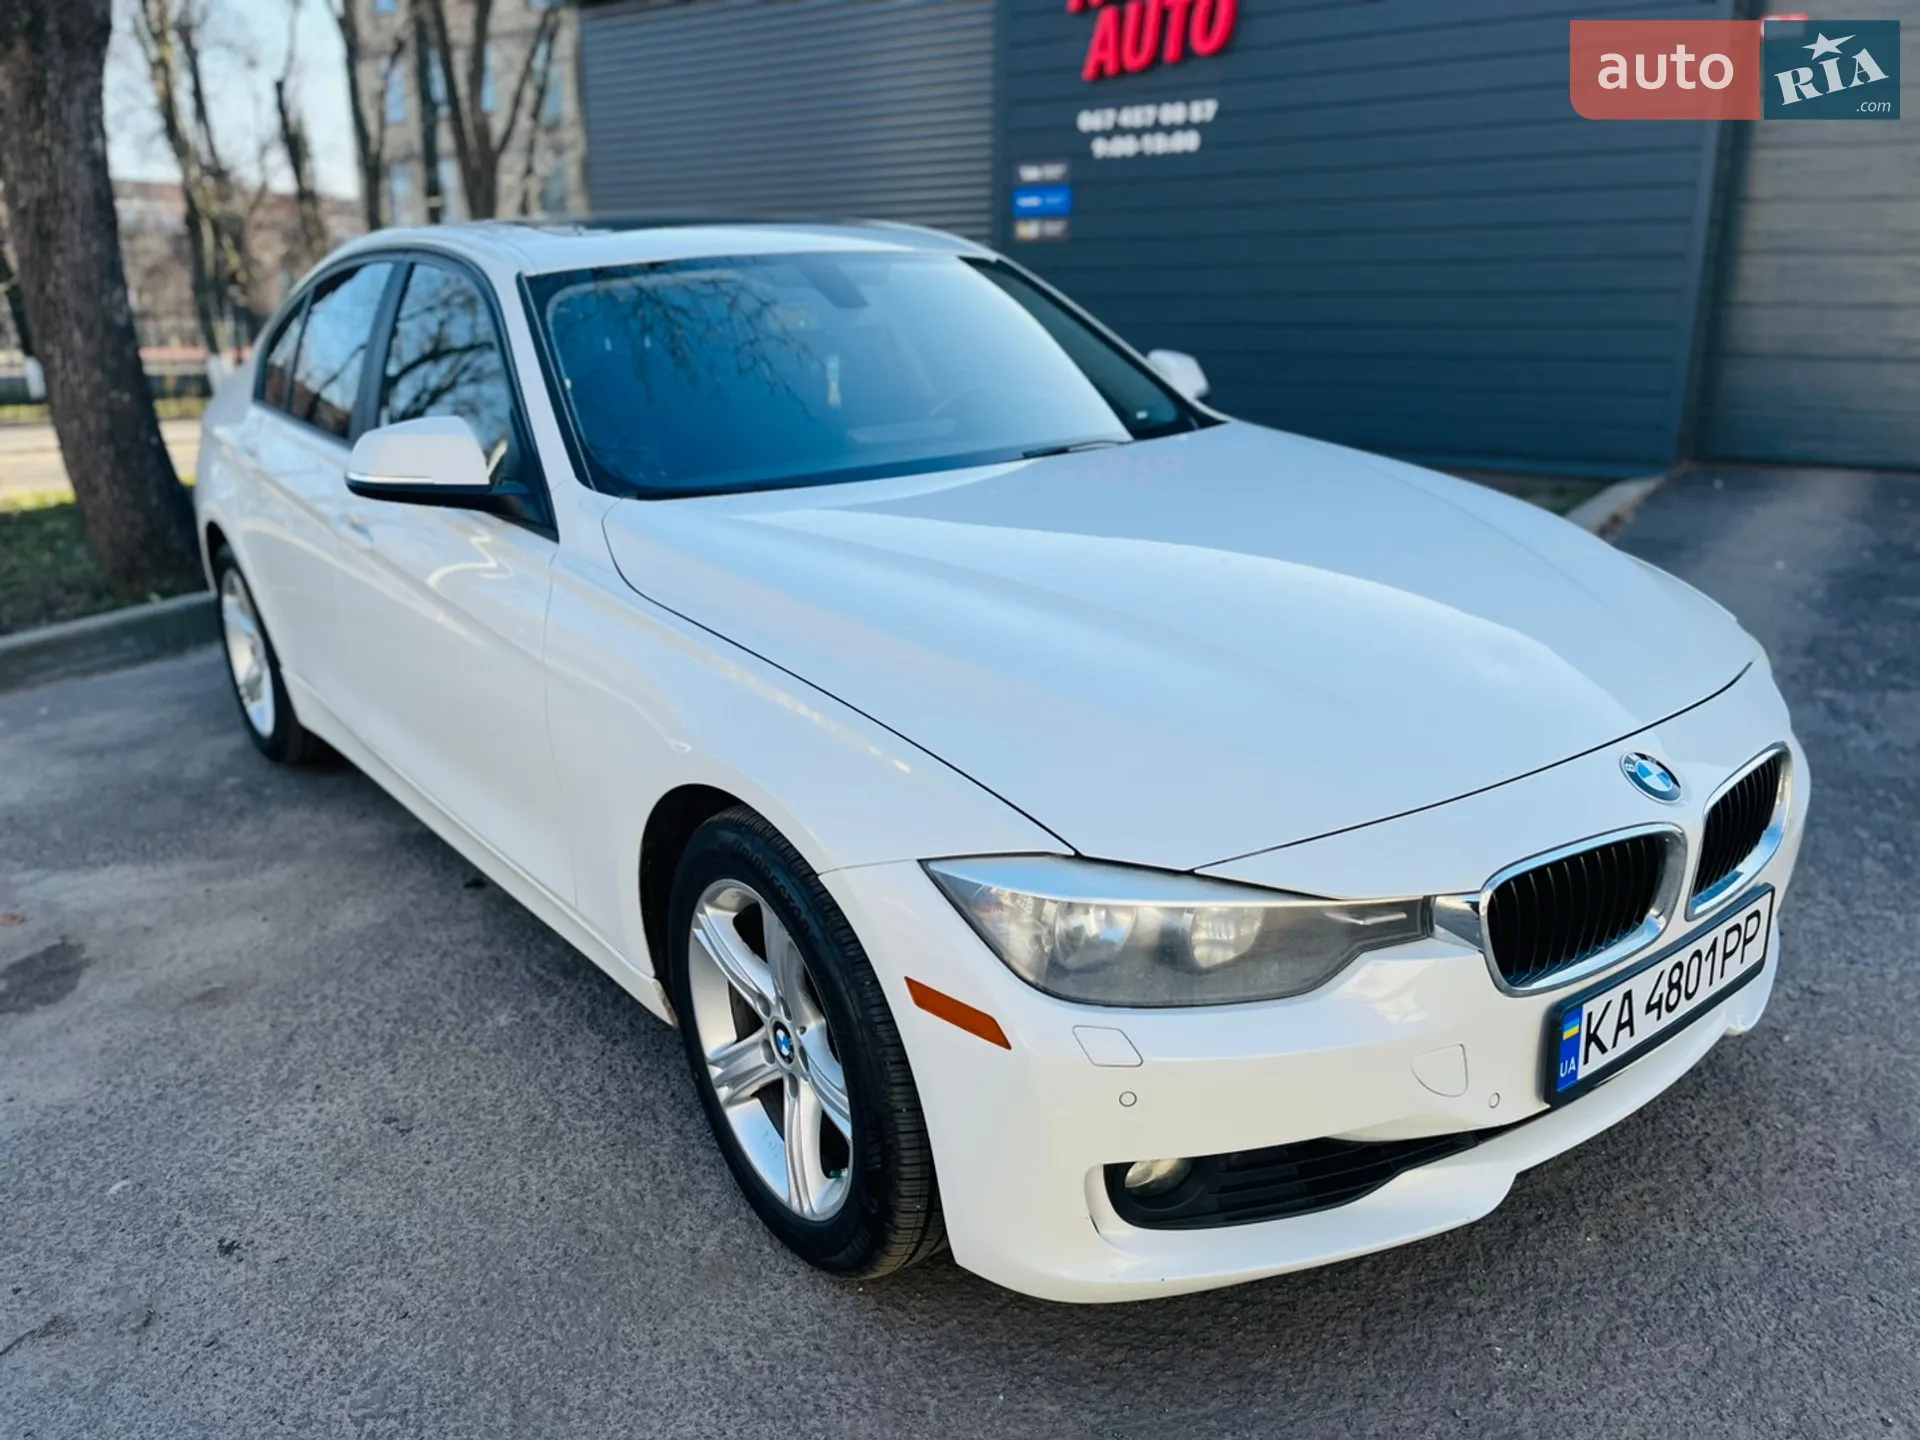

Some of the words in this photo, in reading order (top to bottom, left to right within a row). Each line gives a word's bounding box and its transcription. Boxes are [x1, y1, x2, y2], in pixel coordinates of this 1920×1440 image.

[1081, 0, 1237, 82] AUTO
[1583, 988, 1635, 1066] KA
[1560, 1056, 1576, 1078] UA
